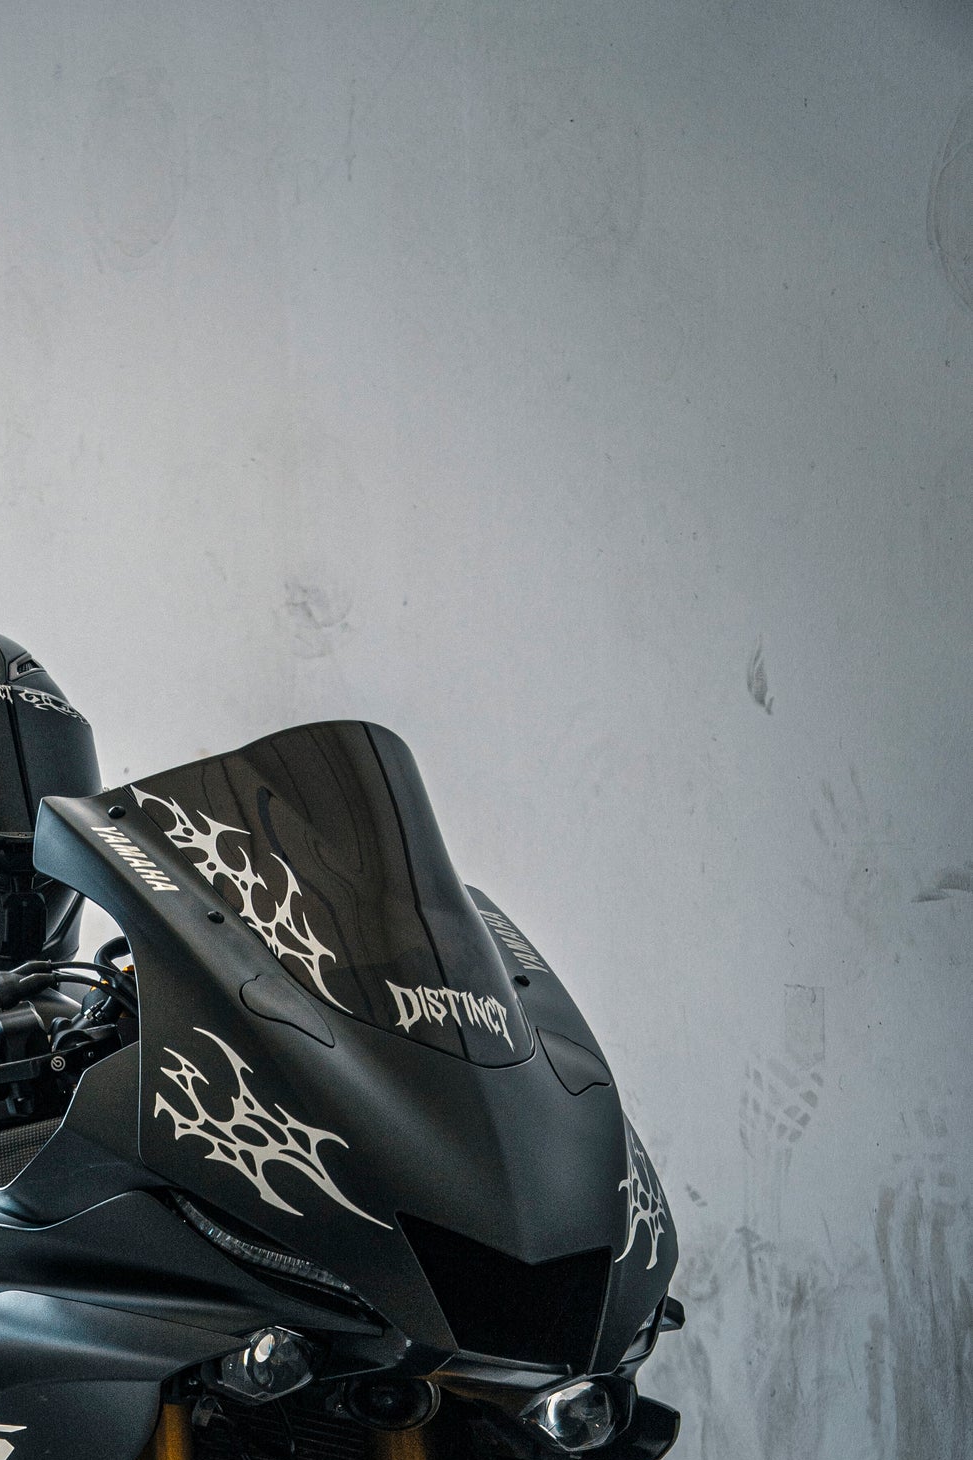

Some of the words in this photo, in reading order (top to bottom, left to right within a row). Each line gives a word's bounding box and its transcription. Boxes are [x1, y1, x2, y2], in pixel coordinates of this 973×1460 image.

[90, 826, 180, 892] YAMAHA
[477, 909, 549, 974] YAMAHA
[385, 979, 515, 1054] DISTINCT
